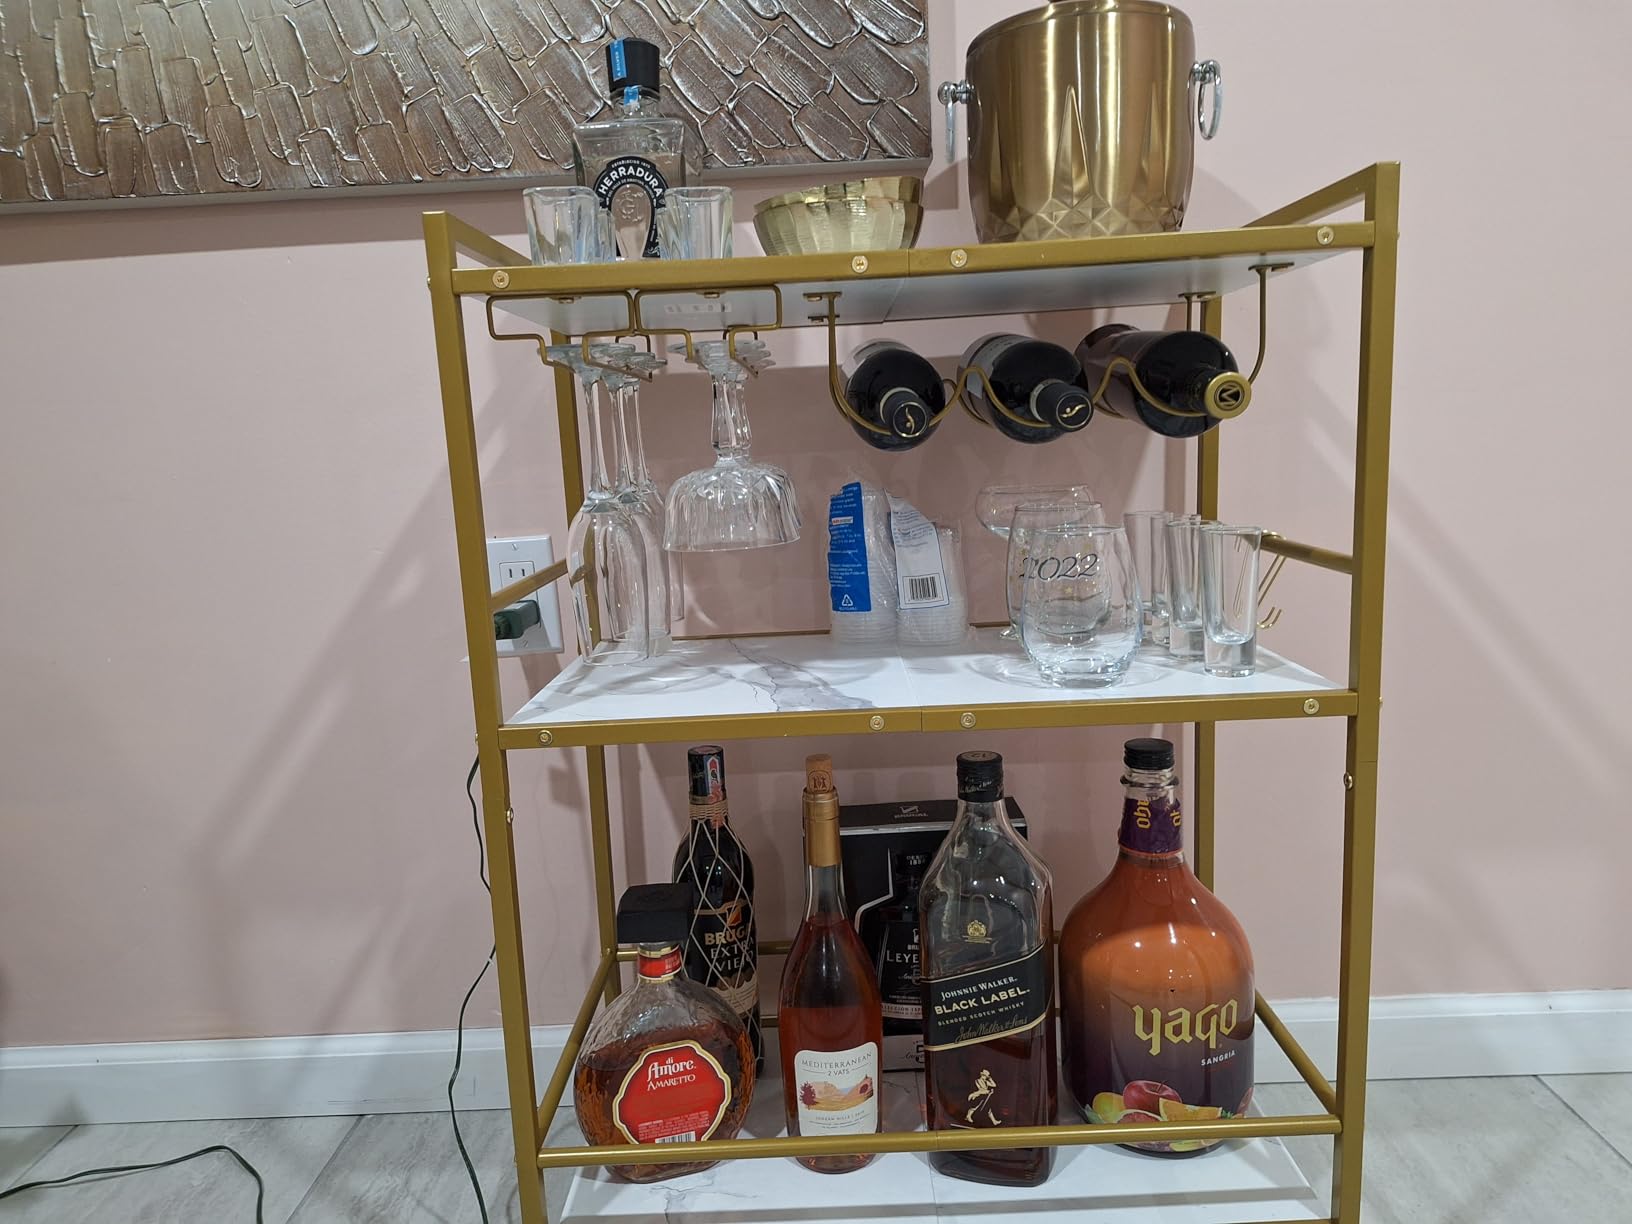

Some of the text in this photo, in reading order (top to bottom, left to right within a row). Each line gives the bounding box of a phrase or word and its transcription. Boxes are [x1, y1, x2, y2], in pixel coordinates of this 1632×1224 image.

[598, 165, 663, 197] HERRADURA
[1019, 553, 1099, 580] 2022
[710, 936, 755, 959] EXTRA
[941, 985, 978, 1001] JOHNNIE
[934, 998, 979, 1015] BLACK
[938, 1001, 1025, 1027] BLENDED SCOTCH WHISKY
[1132, 998, 1238, 1056] yago
[665, 1056, 674, 1065] di
[801, 1051, 872, 1069] MEDITERRANEAN
[1201, 1050, 1236, 1066] SANGRIA
[647, 1059, 695, 1082] Amore
[834, 1068, 850, 1076] VATS
[647, 1073, 696, 1091] AMARETTO
